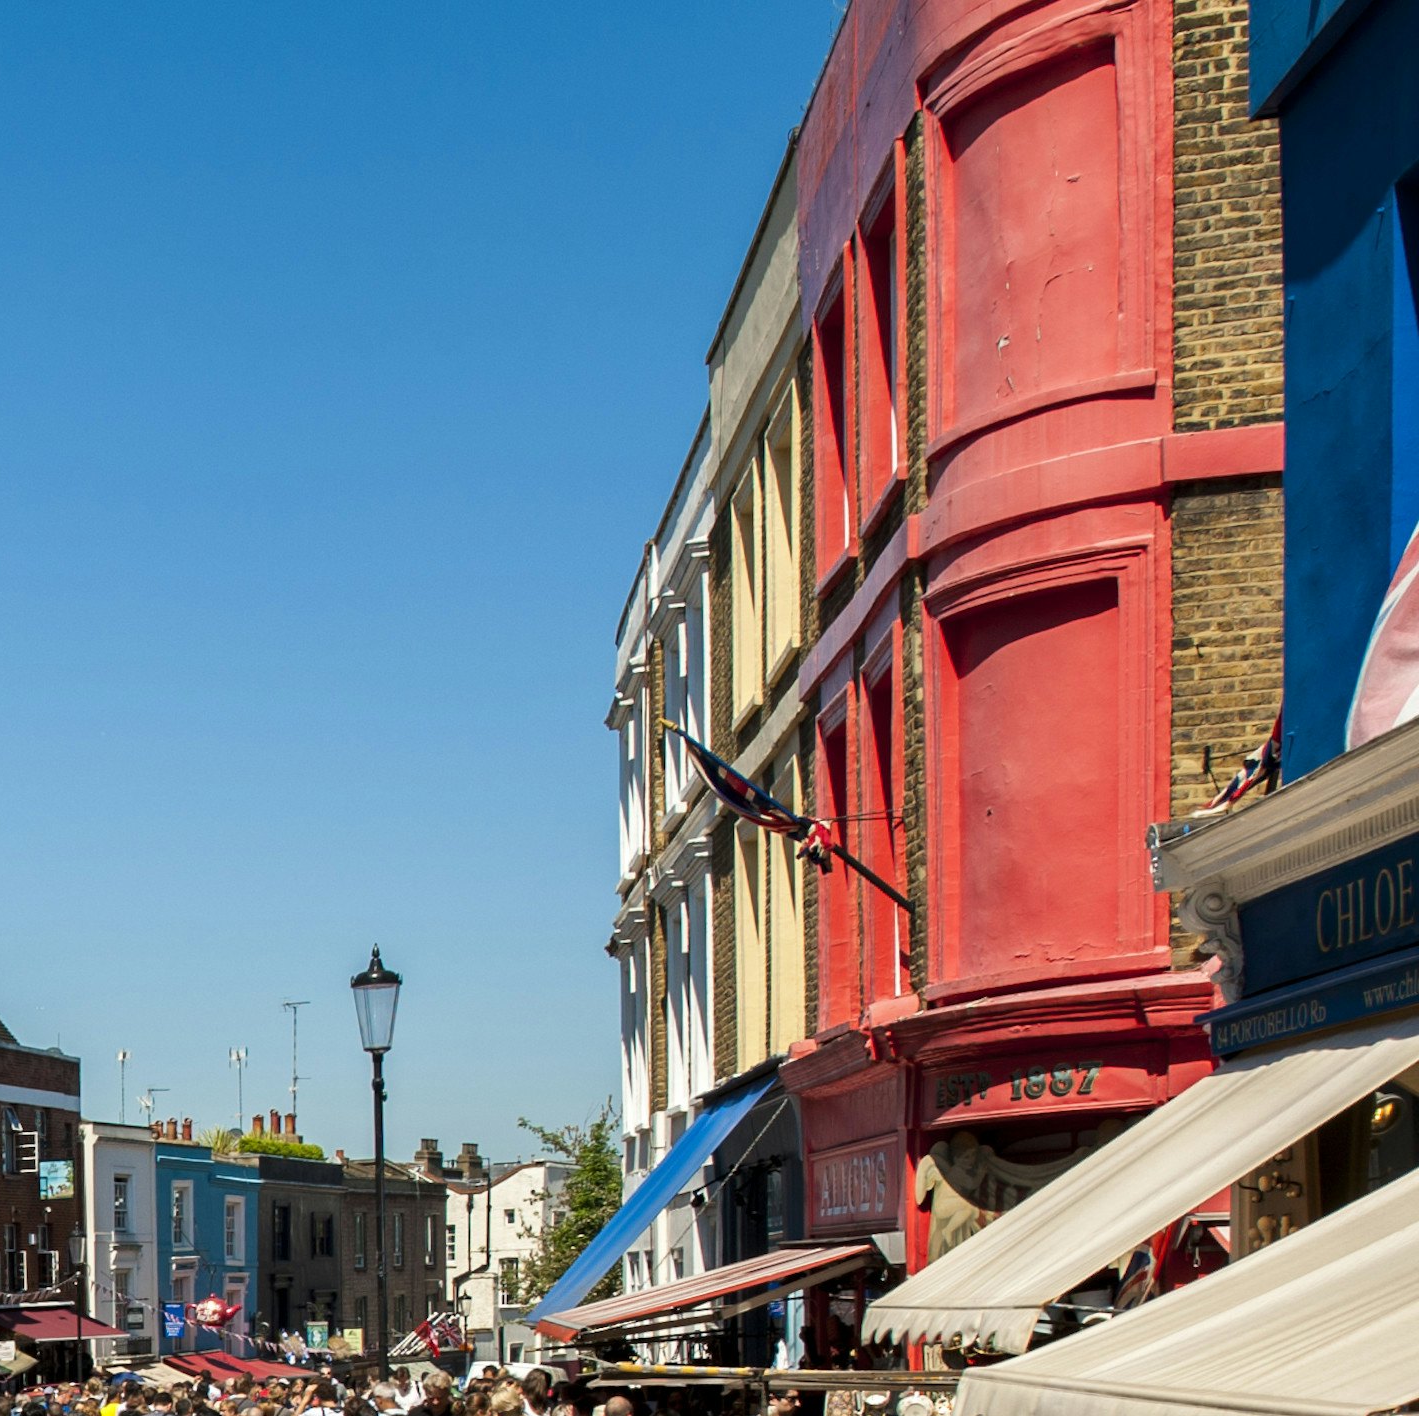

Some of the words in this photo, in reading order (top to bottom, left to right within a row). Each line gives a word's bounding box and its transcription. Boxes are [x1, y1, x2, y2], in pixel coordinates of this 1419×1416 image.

[1316, 857, 1414, 954] CHLOE
[1216, 1026, 1229, 1050] 84
[1230, 1001, 1308, 1047] PORTOBELLO
[1010, 1060, 1103, 1102] 1887
